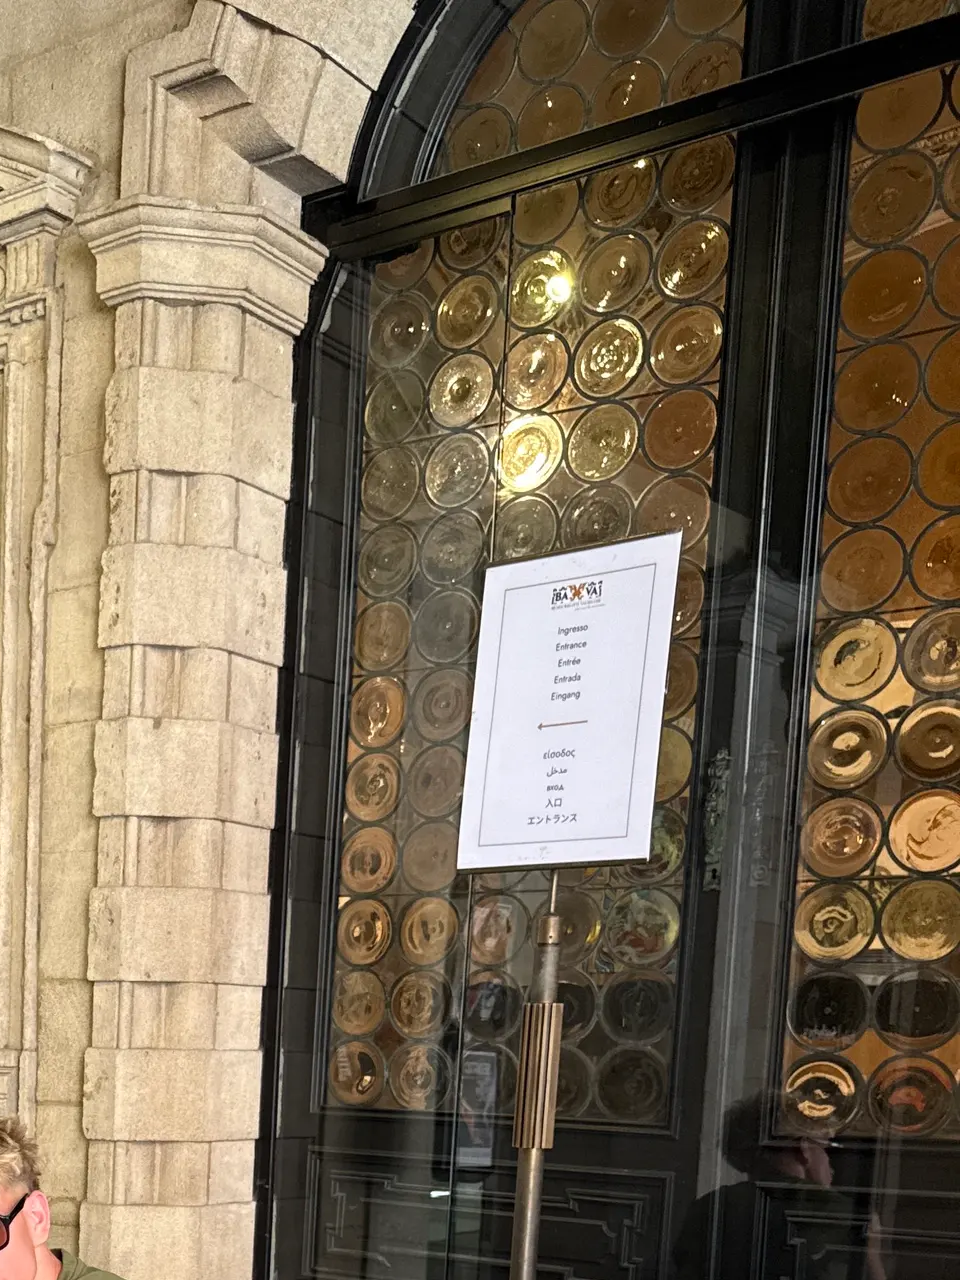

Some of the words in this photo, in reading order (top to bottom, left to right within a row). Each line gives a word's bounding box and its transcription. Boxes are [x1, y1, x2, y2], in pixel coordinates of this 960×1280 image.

[557, 624, 589, 636] Ingresso
[555, 641, 587, 652] Entrance
[557, 656, 581, 668] Entrée
[553, 672, 581, 684] Entrada
[550, 691, 581, 702] Eingang
[542, 748, 576, 760] είσοδος
[546, 766, 568, 777] مدخل
[544, 797, 563, 808] 入口
[527, 813, 578, 825] エントランス
